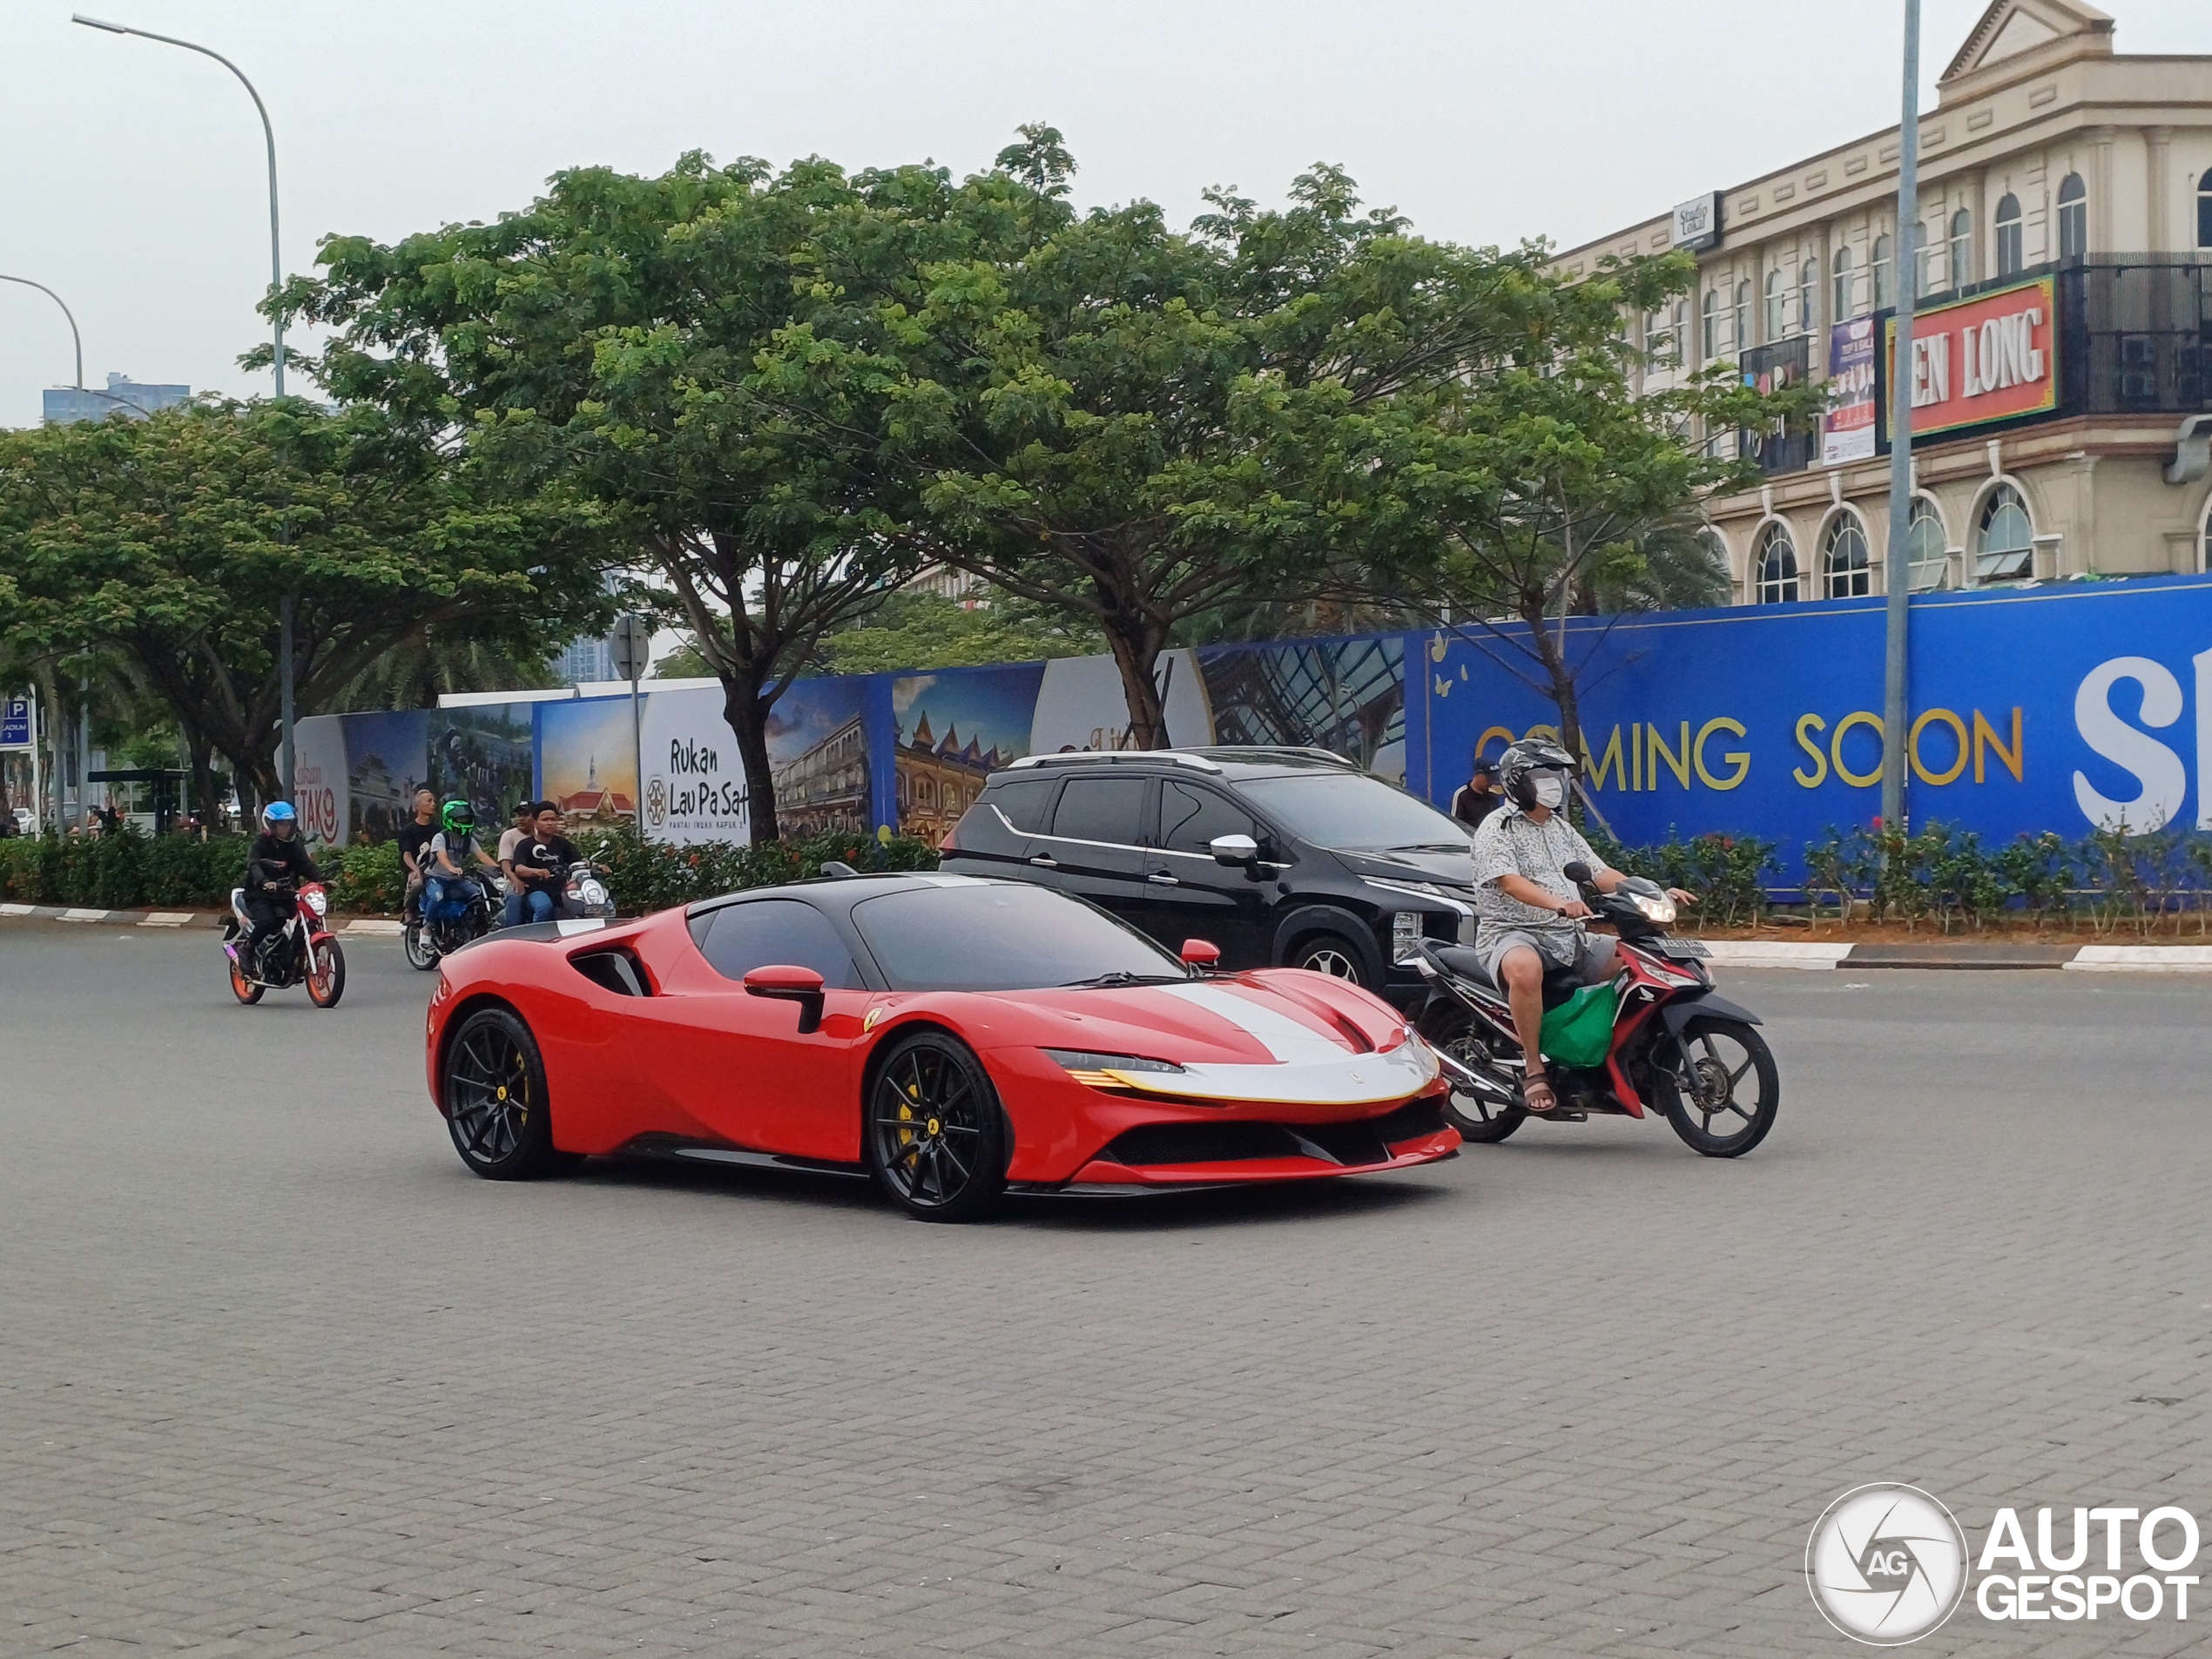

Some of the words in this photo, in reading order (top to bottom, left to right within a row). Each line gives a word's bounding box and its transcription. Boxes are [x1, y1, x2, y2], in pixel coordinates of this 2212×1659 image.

[1911, 332, 1950, 408] EN
[1962, 307, 2045, 398] LONG
[13, 702, 24, 716] P
[671, 737, 718, 775] Rukan
[1474, 716, 1751, 795] CMING
[1792, 706, 2022, 788] SOON
[670, 782, 695, 817] Lau
[698, 781, 718, 817] Pa
[721, 781, 750, 825] Sat
